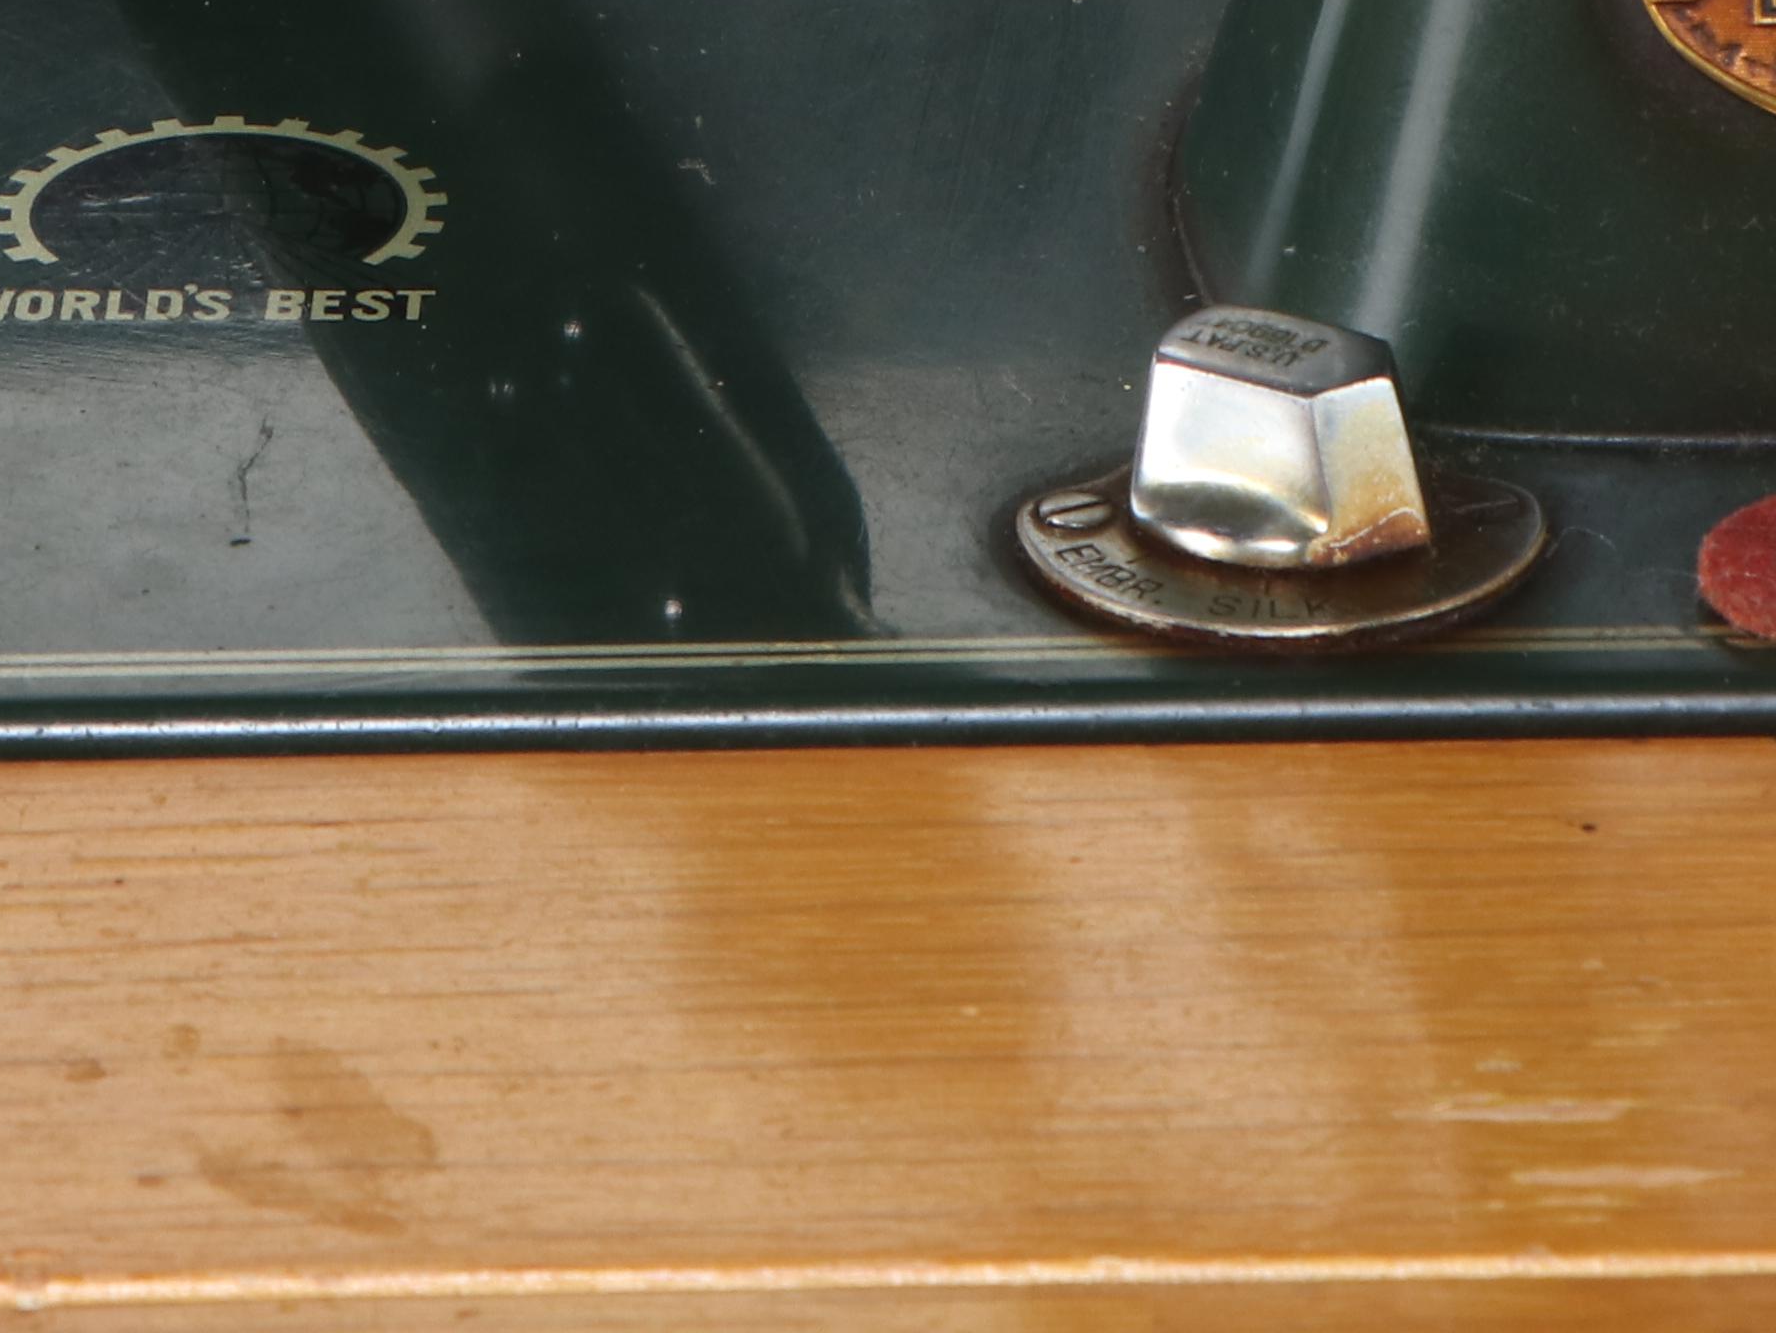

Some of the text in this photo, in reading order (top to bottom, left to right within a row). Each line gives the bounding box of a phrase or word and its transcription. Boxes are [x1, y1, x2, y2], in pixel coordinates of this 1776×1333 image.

[263, 289, 437, 322] BEST
[1054, 542, 1334, 620] EMBR. SILK
